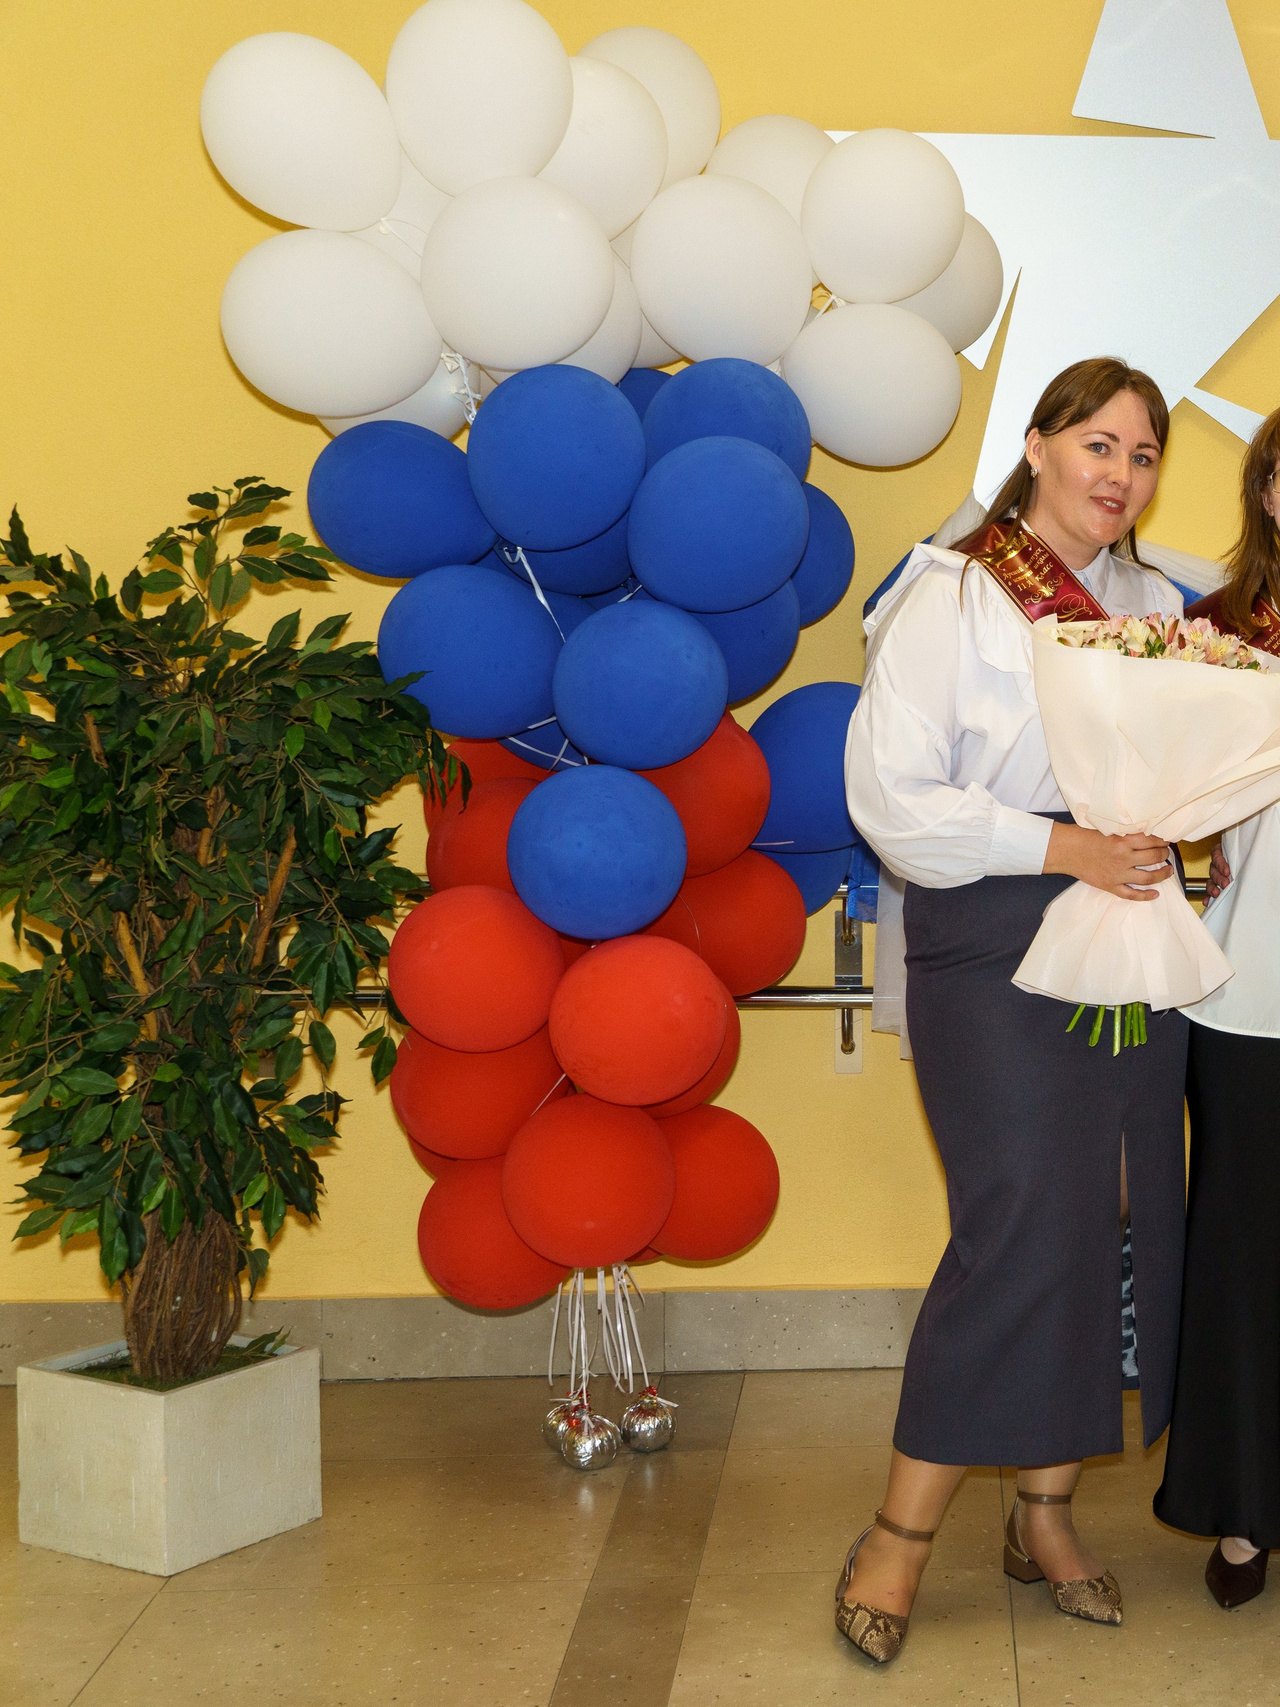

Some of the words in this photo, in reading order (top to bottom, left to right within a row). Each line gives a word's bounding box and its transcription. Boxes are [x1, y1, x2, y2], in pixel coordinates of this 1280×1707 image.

[1025, 547, 1045, 569] выпуск
[1017, 583, 1026, 592] 11
[1035, 562, 1054, 582] класс
